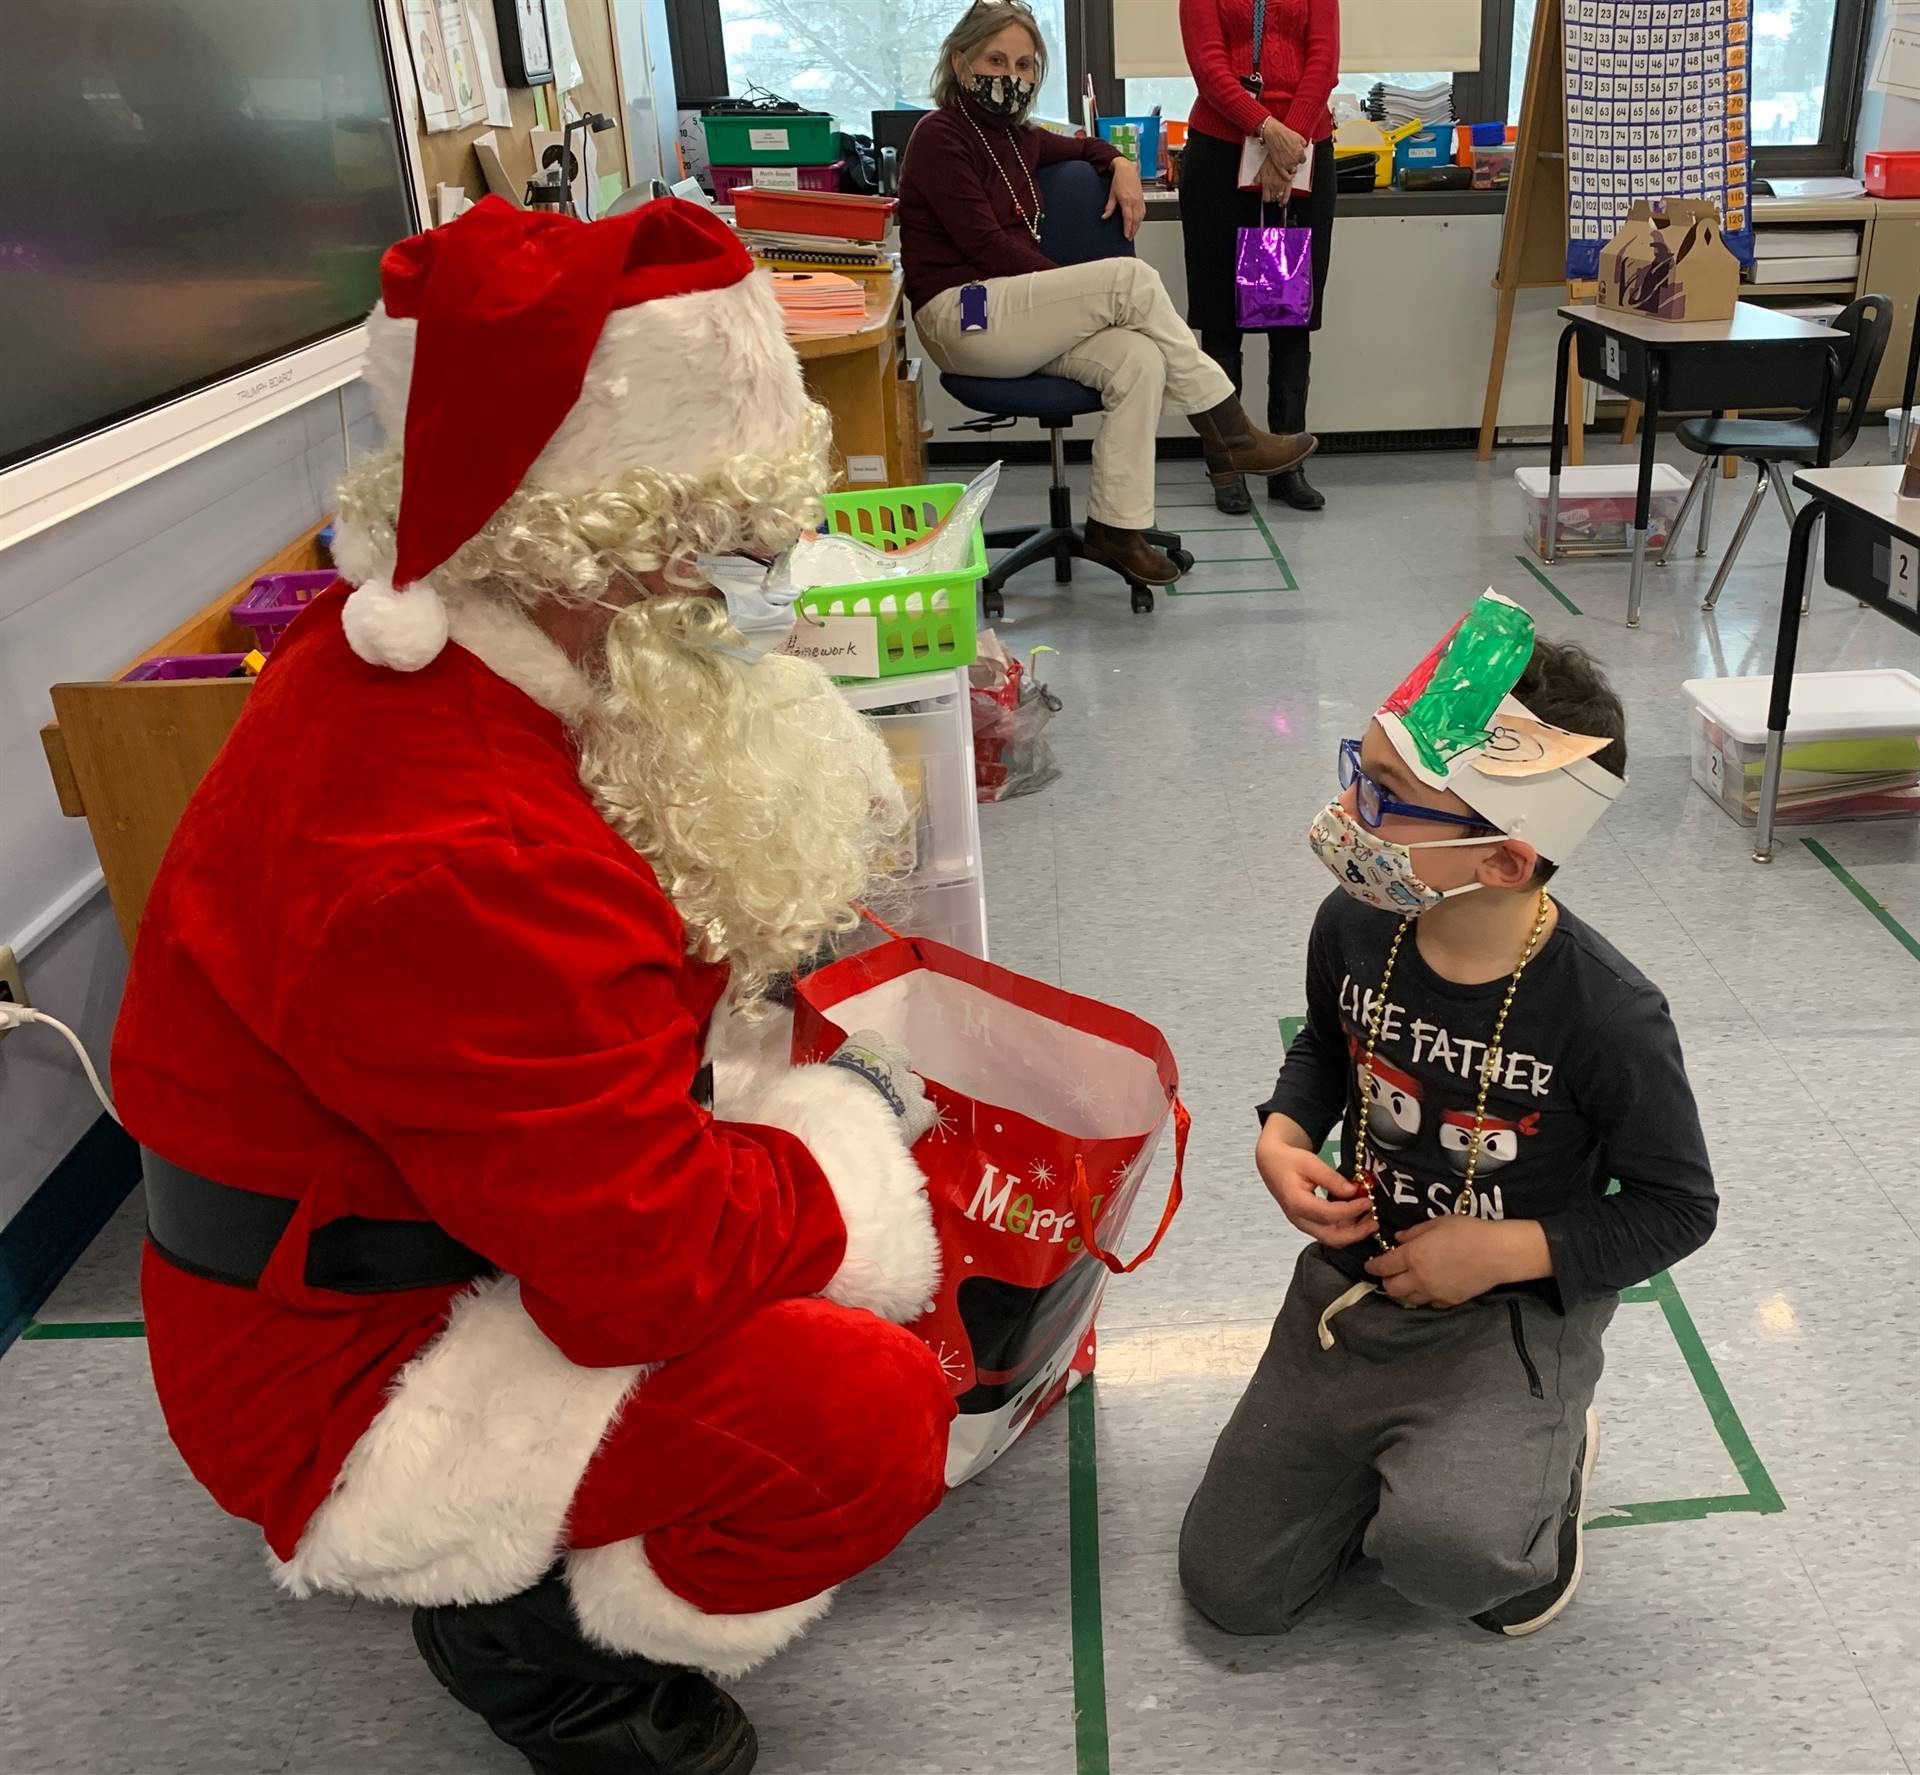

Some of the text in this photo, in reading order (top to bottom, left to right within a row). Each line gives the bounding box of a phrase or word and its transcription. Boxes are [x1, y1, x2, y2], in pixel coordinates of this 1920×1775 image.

[1568, 5, 1576, 14] 21
[1583, 8, 1593, 17] 22
[1601, 9, 1611, 19] 23
[1619, 10, 1630, 19] 24
[1637, 10, 1647, 19] 25
[1656, 10, 1666, 19] 26
[1673, 10, 1683, 19] 27
[1690, 9, 1700, 18] 28
[1709, 6, 1721, 16] 29
[1569, 30, 1577, 39] 31
[1583, 32, 1593, 42] 32
[1600, 34, 1610, 43] 33
[1618, 35, 1628, 44] 34
[1636, 35, 1647, 44] 35
[1653, 34, 1663, 43] 36
[1672, 34, 1682, 43] 37
[1689, 32, 1699, 42] 38
[1708, 30, 1720, 40] 39
[1568, 53, 1576, 63] 41
[1583, 57, 1594, 65] 42
[1601, 59, 1611, 68] 43
[1616, 59, 1627, 68] 44
[1635, 59, 1645, 68] 45
[1652, 59, 1662, 68] 46
[1669, 58, 1679, 67] 47
[1687, 57, 1699, 65] 48
[1707, 54, 1720, 63] 49
[1569, 79, 1576, 88] 51
[1584, 81, 1593, 90] 52
[1601, 83, 1610, 92] 53
[1617, 83, 1627, 92] 54
[1634, 83, 1644, 92] 55
[1650, 83, 1661, 92] 56
[1668, 82, 1678, 91] 57
[1687, 81, 1698, 90] 58
[1708, 78, 1720, 88] 59
[1570, 105, 1578, 114] 61
[1585, 106, 1594, 115] 62
[1600, 107, 1610, 116] 63
[1616, 107, 1626, 116] 64
[1633, 107, 1643, 116] 65
[1650, 107, 1660, 116] 66
[1668, 106, 1678, 115] 67
[1686, 104, 1697, 113] 68
[1731, 98, 1743, 107] 70
[692, 117, 698, 125] 5
[1572, 128, 1579, 137] 71
[1585, 130, 1593, 139] 72
[1600, 131, 1609, 139] 73
[1616, 132, 1625, 140] 74
[1633, 131, 1642, 140] 75
[1649, 131, 1659, 139] 76
[1667, 130, 1678, 138] 77
[1686, 128, 1697, 137] 78
[1708, 125, 1719, 135] 79
[1572, 152, 1579, 160] 81
[1586, 153, 1594, 162] 82
[1600, 154, 1609, 163] 83
[1616, 155, 1625, 163] 84
[1633, 155, 1642, 163] 85
[1649, 154, 1659, 163] 86
[1667, 153, 1677, 161] 87
[1686, 151, 1697, 160] 88
[1707, 148, 1719, 157] 89
[1573, 176, 1579, 185] 91
[1586, 178, 1595, 187] 92
[1601, 179, 1610, 187] 93
[1617, 179, 1626, 187] 94
[1634, 179, 1644, 187] 95
[1650, 178, 1660, 186] 96
[1667, 176, 1678, 185] 97
[1687, 174, 1698, 183] 98
[1707, 172, 1720, 180] 99
[1573, 200, 1581, 209] 101
[1586, 202, 1597, 210] 102
[1602, 202, 1612, 210] 103
[1617, 202, 1628, 210] 104
[1731, 192, 1744, 201] 110
[1572, 225, 1580, 234] 111
[1588, 225, 1597, 233] 112
[1604, 225, 1613, 233] 113
[1729, 214, 1744, 225] 120
[1610, 346, 1615, 363] 3
[1899, 554, 1908, 581] 2
[1711, 755, 1718, 776] 2
[1339, 974, 1554, 1097] LIKE FATHER
[1361, 1147, 1505, 1221] IKE SON
